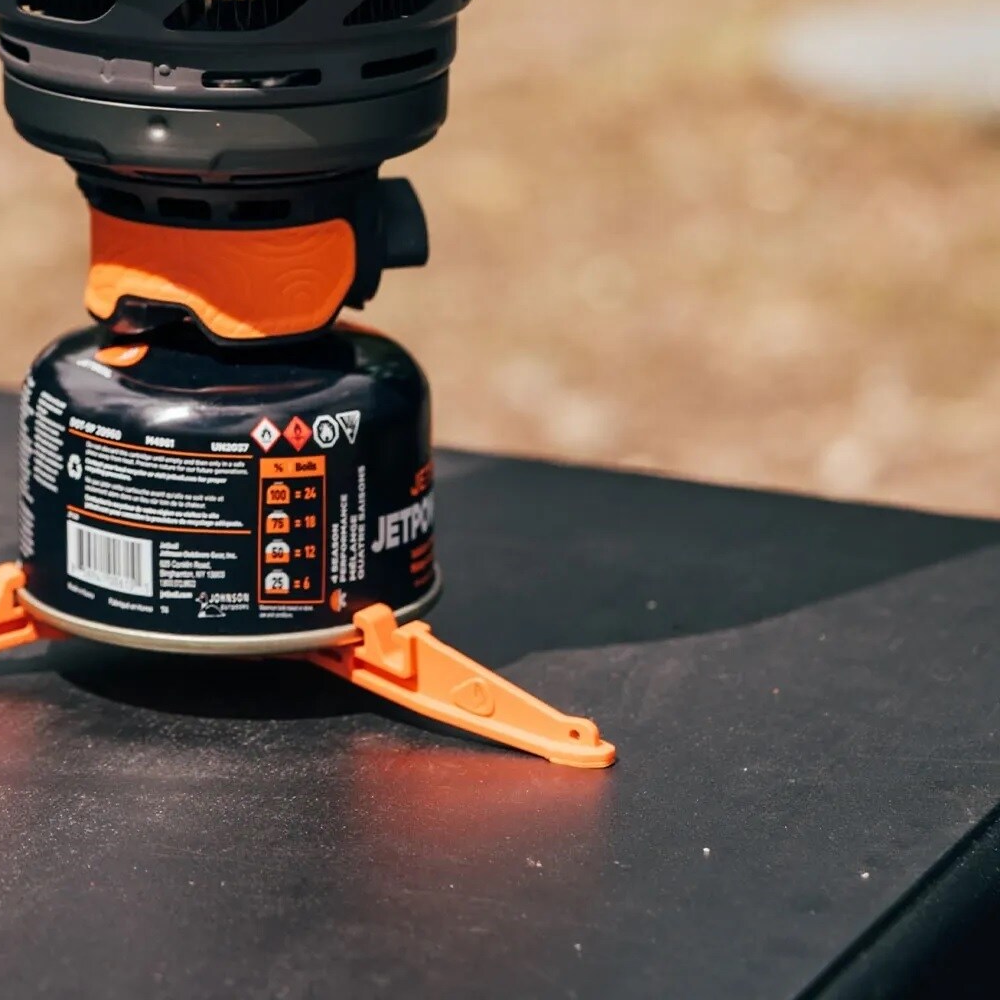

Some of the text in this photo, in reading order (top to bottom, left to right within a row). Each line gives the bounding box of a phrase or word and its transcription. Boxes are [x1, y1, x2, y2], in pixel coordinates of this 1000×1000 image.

[273, 462, 318, 473] % Boils
[270, 489, 287, 501] 100
[304, 487, 317, 500] 24
[272, 519, 285, 530] 75
[357, 464, 366, 580] QUATRE SAISONS
[339, 493, 349, 583] PERFORMANCE
[271, 547, 284, 560] 50
[304, 545, 317, 559] 12
[331, 522, 340, 584] 4 SEASON
[271, 577, 284, 590] 25
[302, 576, 311, 590] 6
[210, 592, 250, 604] JOHNSON
